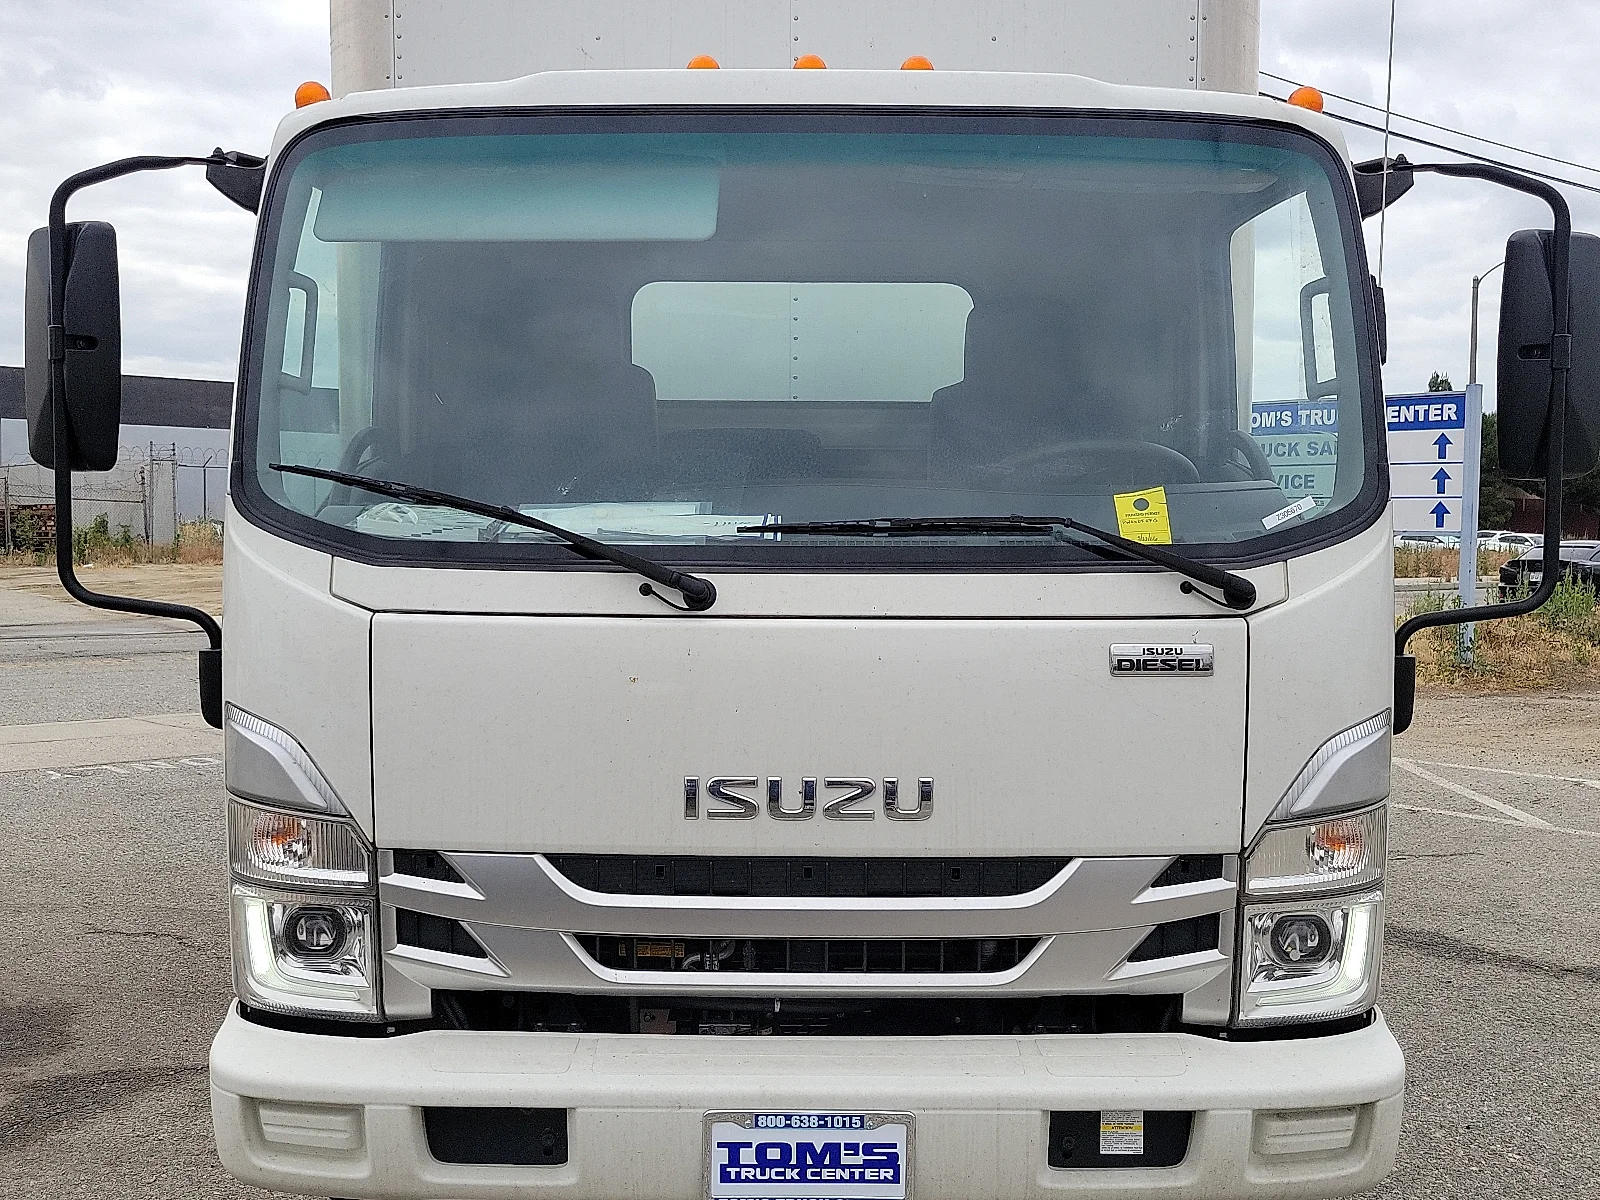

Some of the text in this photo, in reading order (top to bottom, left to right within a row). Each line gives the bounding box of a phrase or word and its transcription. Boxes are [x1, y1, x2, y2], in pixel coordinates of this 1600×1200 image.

[1251, 403, 1458, 428] OM'S TRU ENTER
[1260, 442, 1301, 458] UCK
[1276, 474, 1315, 490] VICE
[1142, 647, 1184, 656] ISUZU
[1116, 658, 1211, 672] DIESEL
[684, 776, 934, 821] ISUZU
[757, 1115, 861, 1128] 800-638-1015
[726, 1168, 894, 1180] TRUCK CENTER
